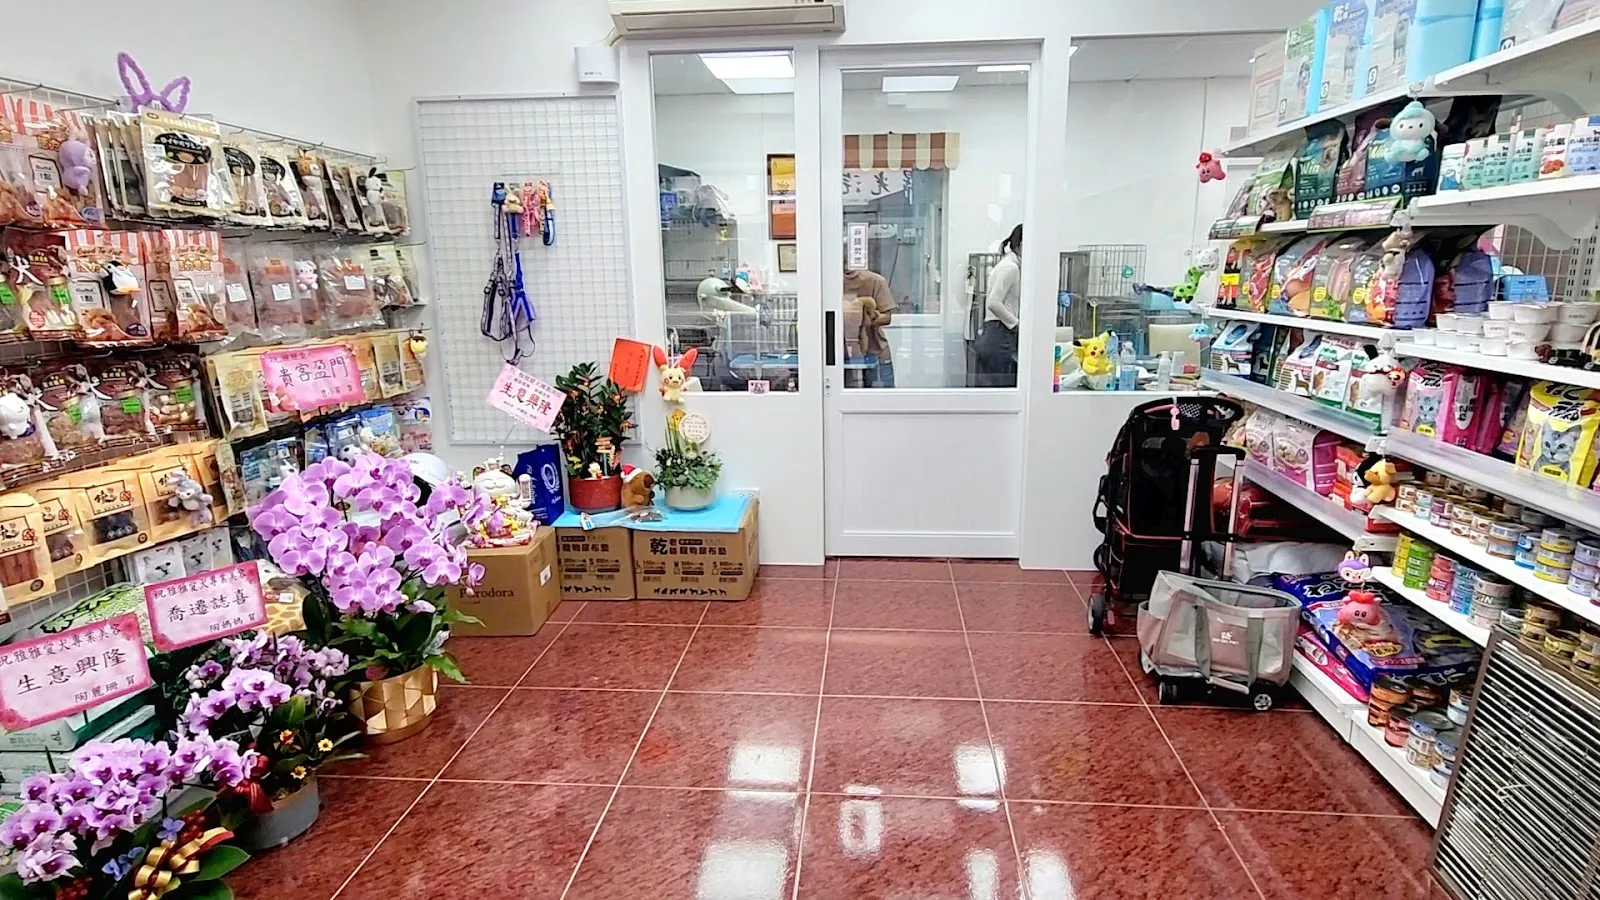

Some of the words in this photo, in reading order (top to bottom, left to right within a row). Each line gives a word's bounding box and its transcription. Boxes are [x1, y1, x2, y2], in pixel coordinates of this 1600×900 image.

[279, 356, 349, 388] 貴客盈門
[500, 381, 552, 416] 生意興隆
[650, 537, 668, 556] 乾
[167, 588, 250, 622] 喬遷誌喜
[459, 587, 515, 599] Prodora
[17, 648, 127, 695] 生意興隆
